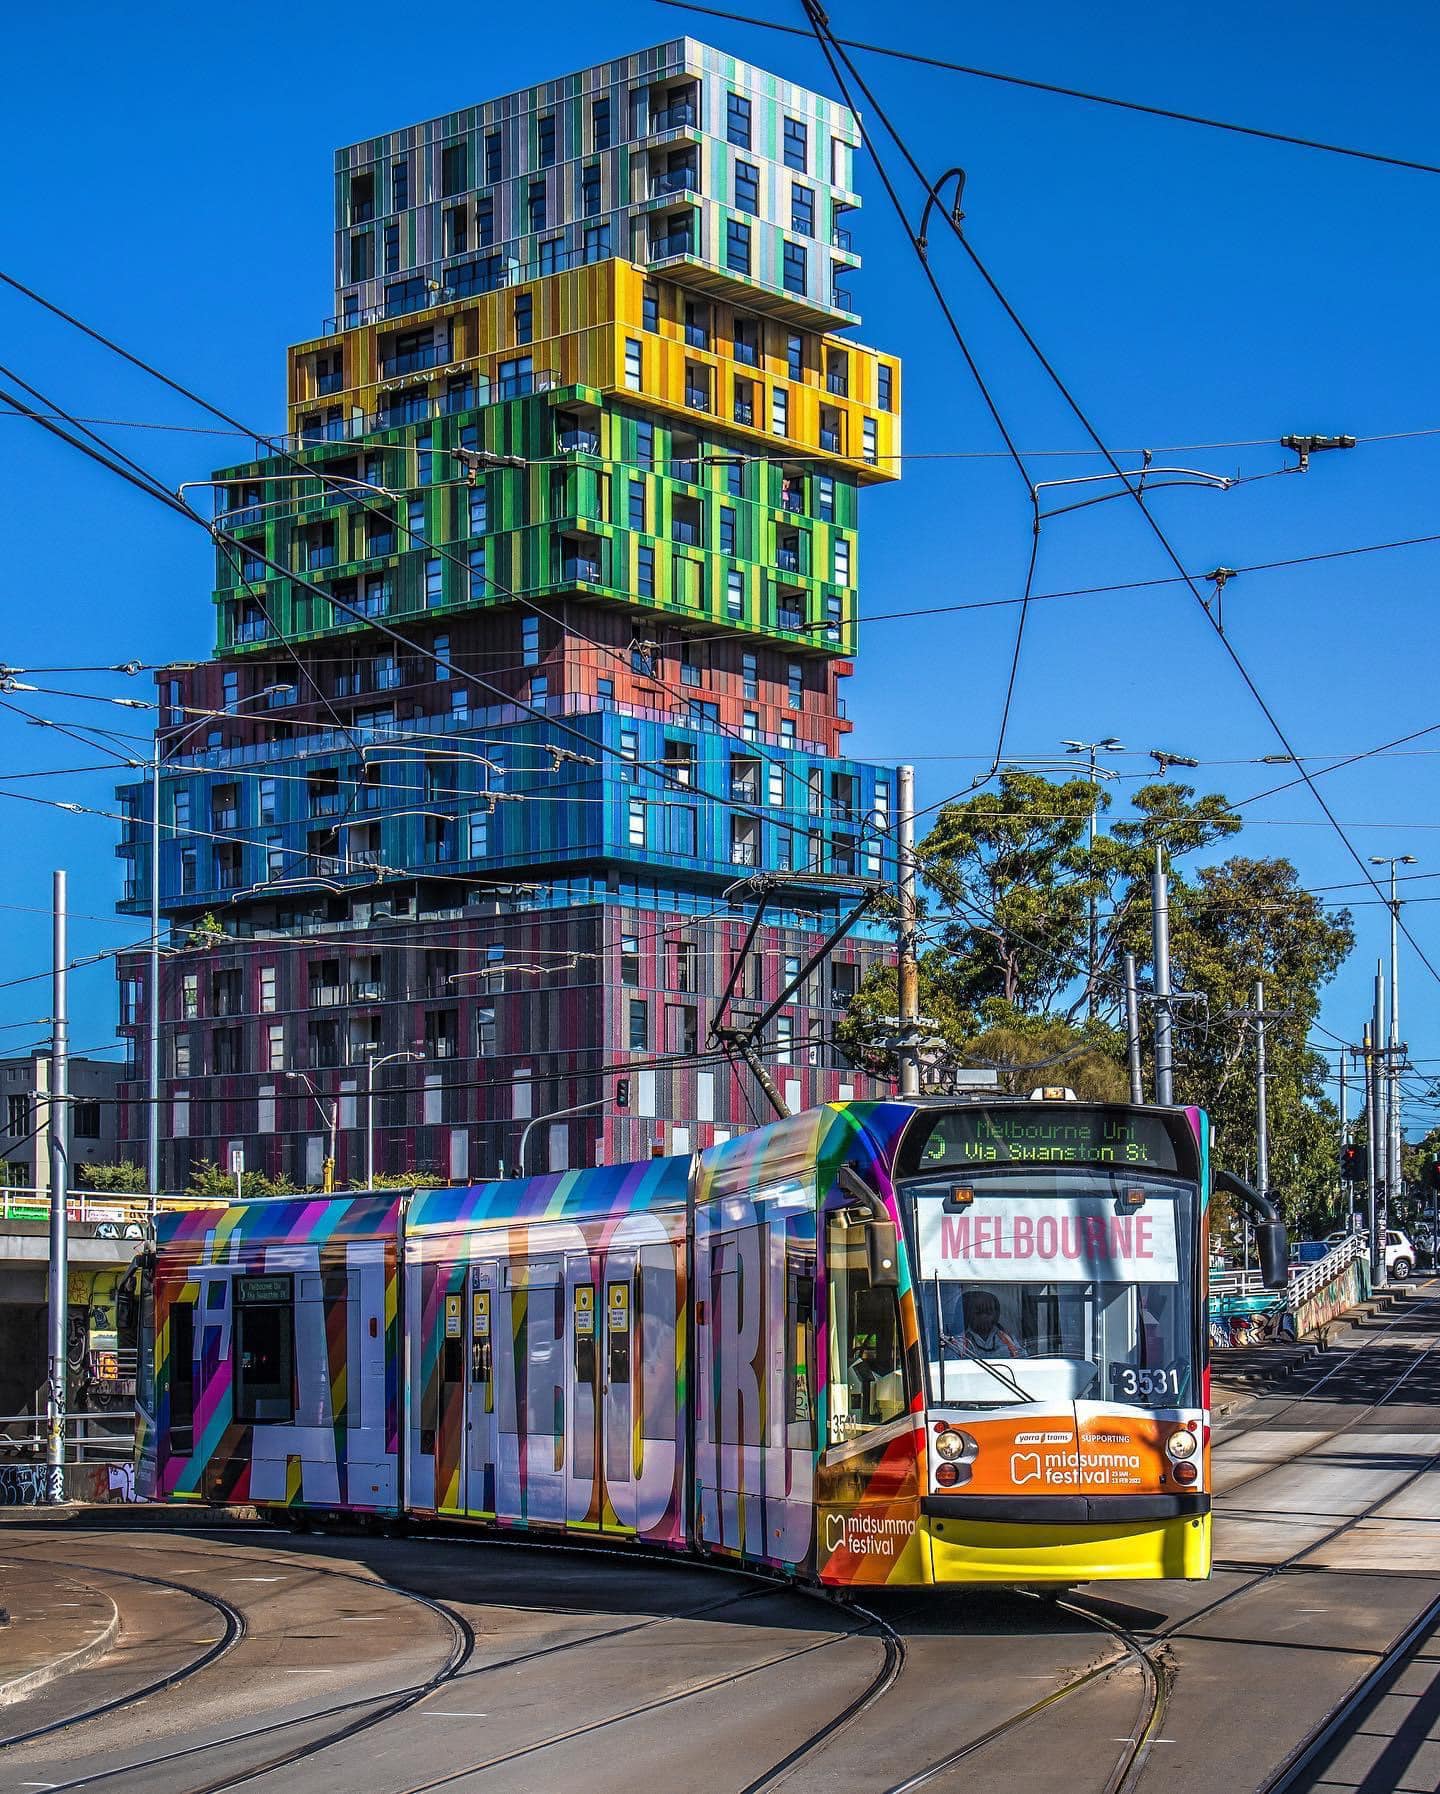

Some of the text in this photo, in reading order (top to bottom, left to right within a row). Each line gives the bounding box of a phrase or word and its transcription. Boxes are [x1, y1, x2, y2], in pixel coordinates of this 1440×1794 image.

[977, 1120, 1136, 1139] Melbourne Uni
[965, 1142, 1148, 1161] Via Swanston St
[941, 1216, 1154, 1260] MELBOURNE
[1122, 1368, 1180, 1395] 3531
[1019, 1434, 1069, 1443] yarra trams
[1081, 1434, 1131, 1444] SUPPORTING
[1045, 1450, 1140, 1468] midsumma
[1045, 1467, 1110, 1484] festival
[848, 1516, 916, 1537] midsumma
[848, 1535, 894, 1556] festival
